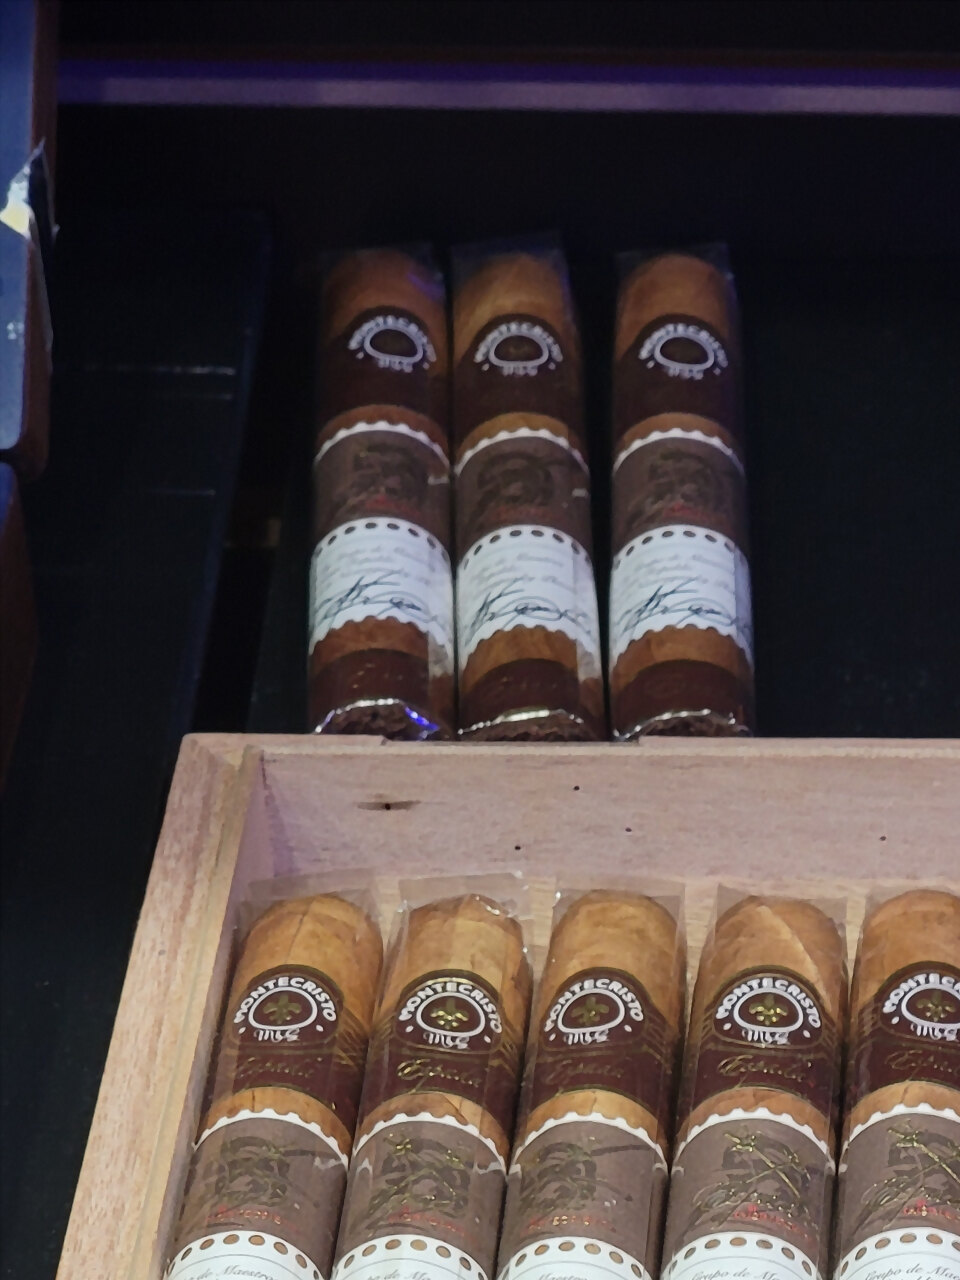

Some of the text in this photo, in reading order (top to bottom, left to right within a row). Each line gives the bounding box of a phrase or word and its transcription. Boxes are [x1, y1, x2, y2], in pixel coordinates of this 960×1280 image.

[233, 976, 337, 1024] MONTECRISTO
[398, 982, 503, 1033] MONTECRISTO
[544, 978, 644, 1032] MONTECRISTO
[716, 977, 822, 1028] MONTECRISTO
